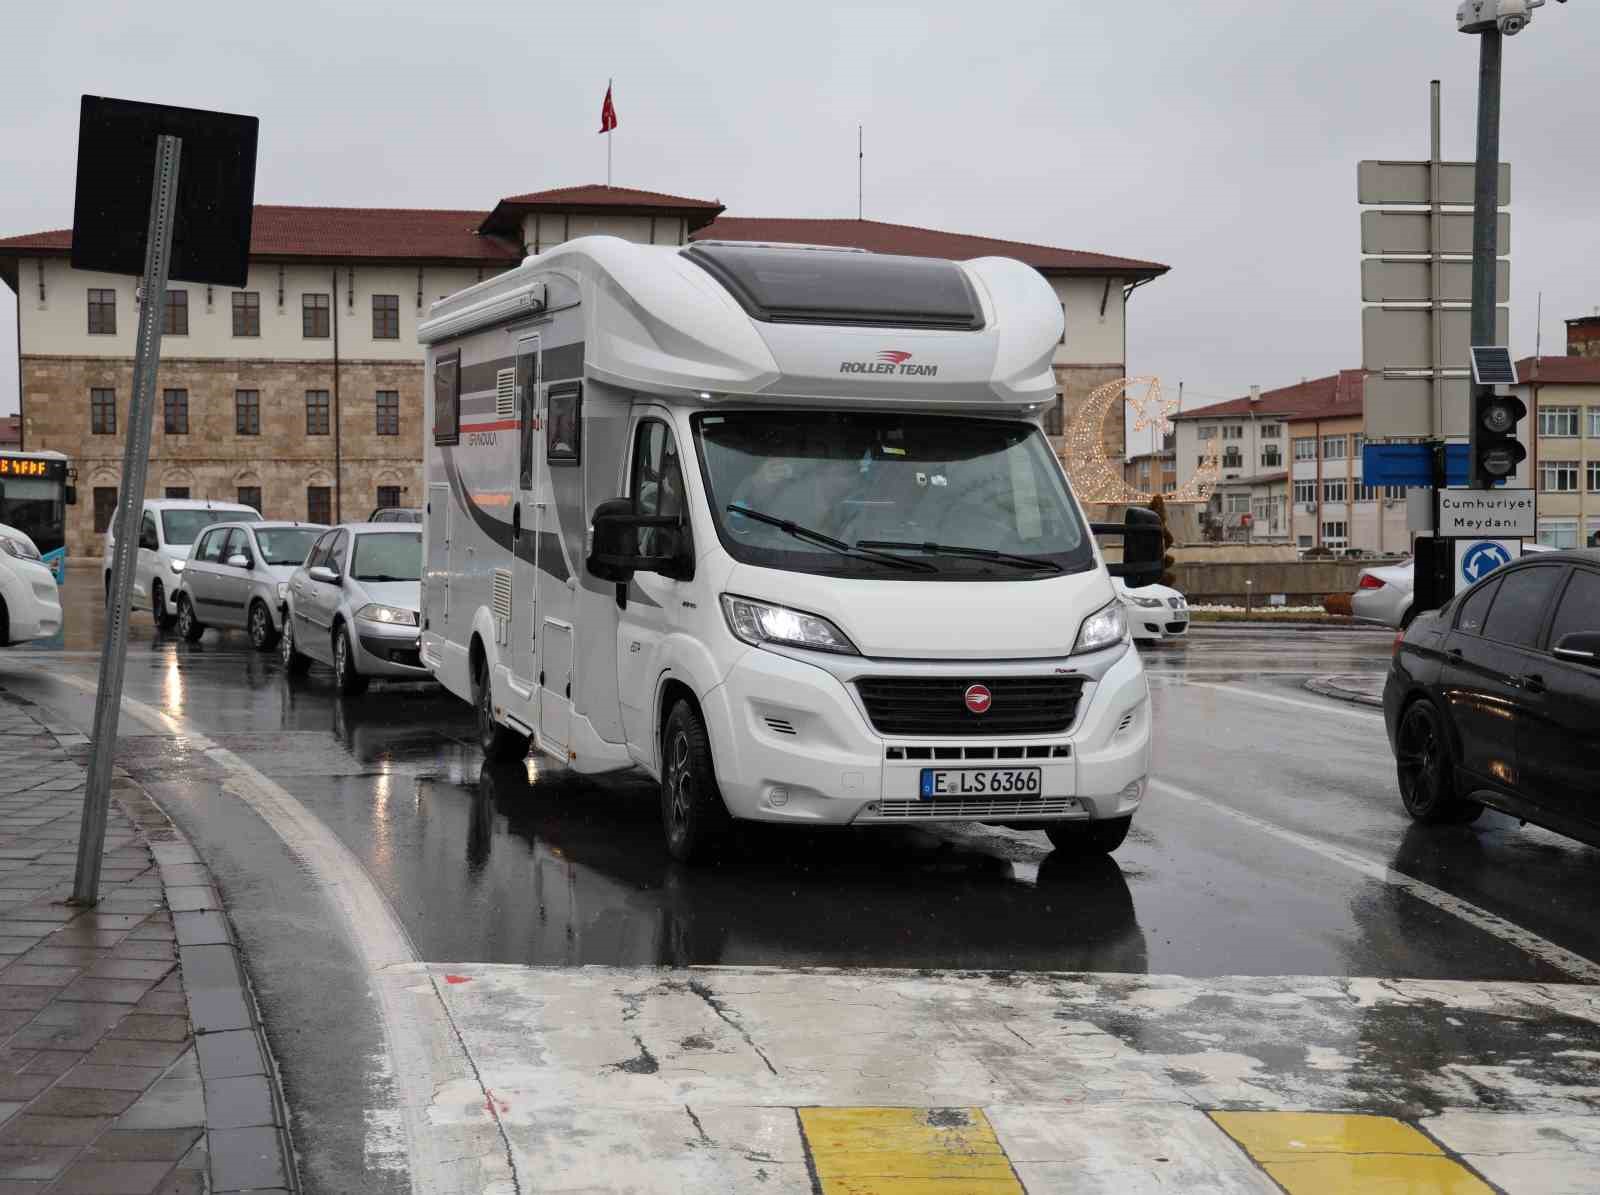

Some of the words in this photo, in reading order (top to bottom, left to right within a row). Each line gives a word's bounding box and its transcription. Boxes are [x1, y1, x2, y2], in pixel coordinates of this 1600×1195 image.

[840, 361, 896, 375] ROLLER
[899, 363, 938, 377] TEAM
[1442, 498, 1532, 510] Cumhuriyet
[1454, 516, 1517, 529] Meydanı
[935, 772, 947, 793] E
[961, 772, 987, 792] LS
[990, 771, 1037, 792] 6366
